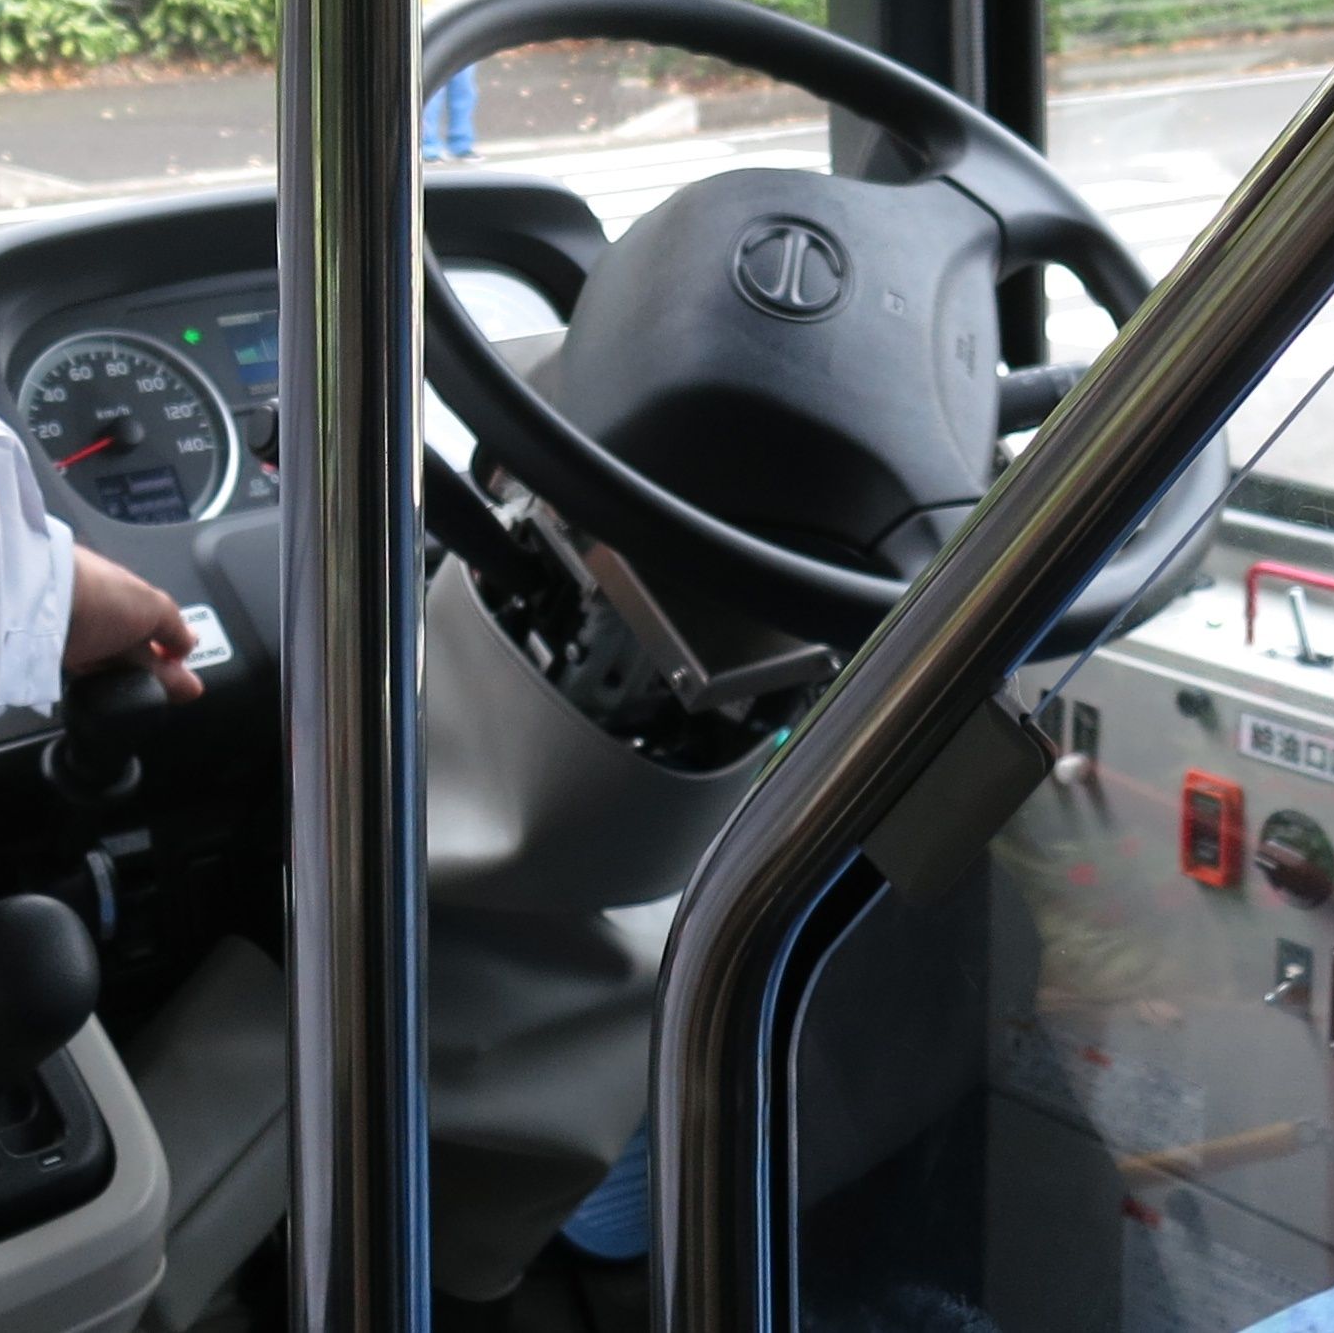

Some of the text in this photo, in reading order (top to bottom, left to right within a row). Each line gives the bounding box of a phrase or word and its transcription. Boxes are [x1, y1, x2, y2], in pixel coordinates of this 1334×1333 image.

[69, 366, 93, 382] 60
[106, 362, 129, 377] 80
[136, 376, 166, 393] 100
[164, 404, 193, 420] 120
[38, 423, 62, 439] 20
[177, 437, 205, 454] 140
